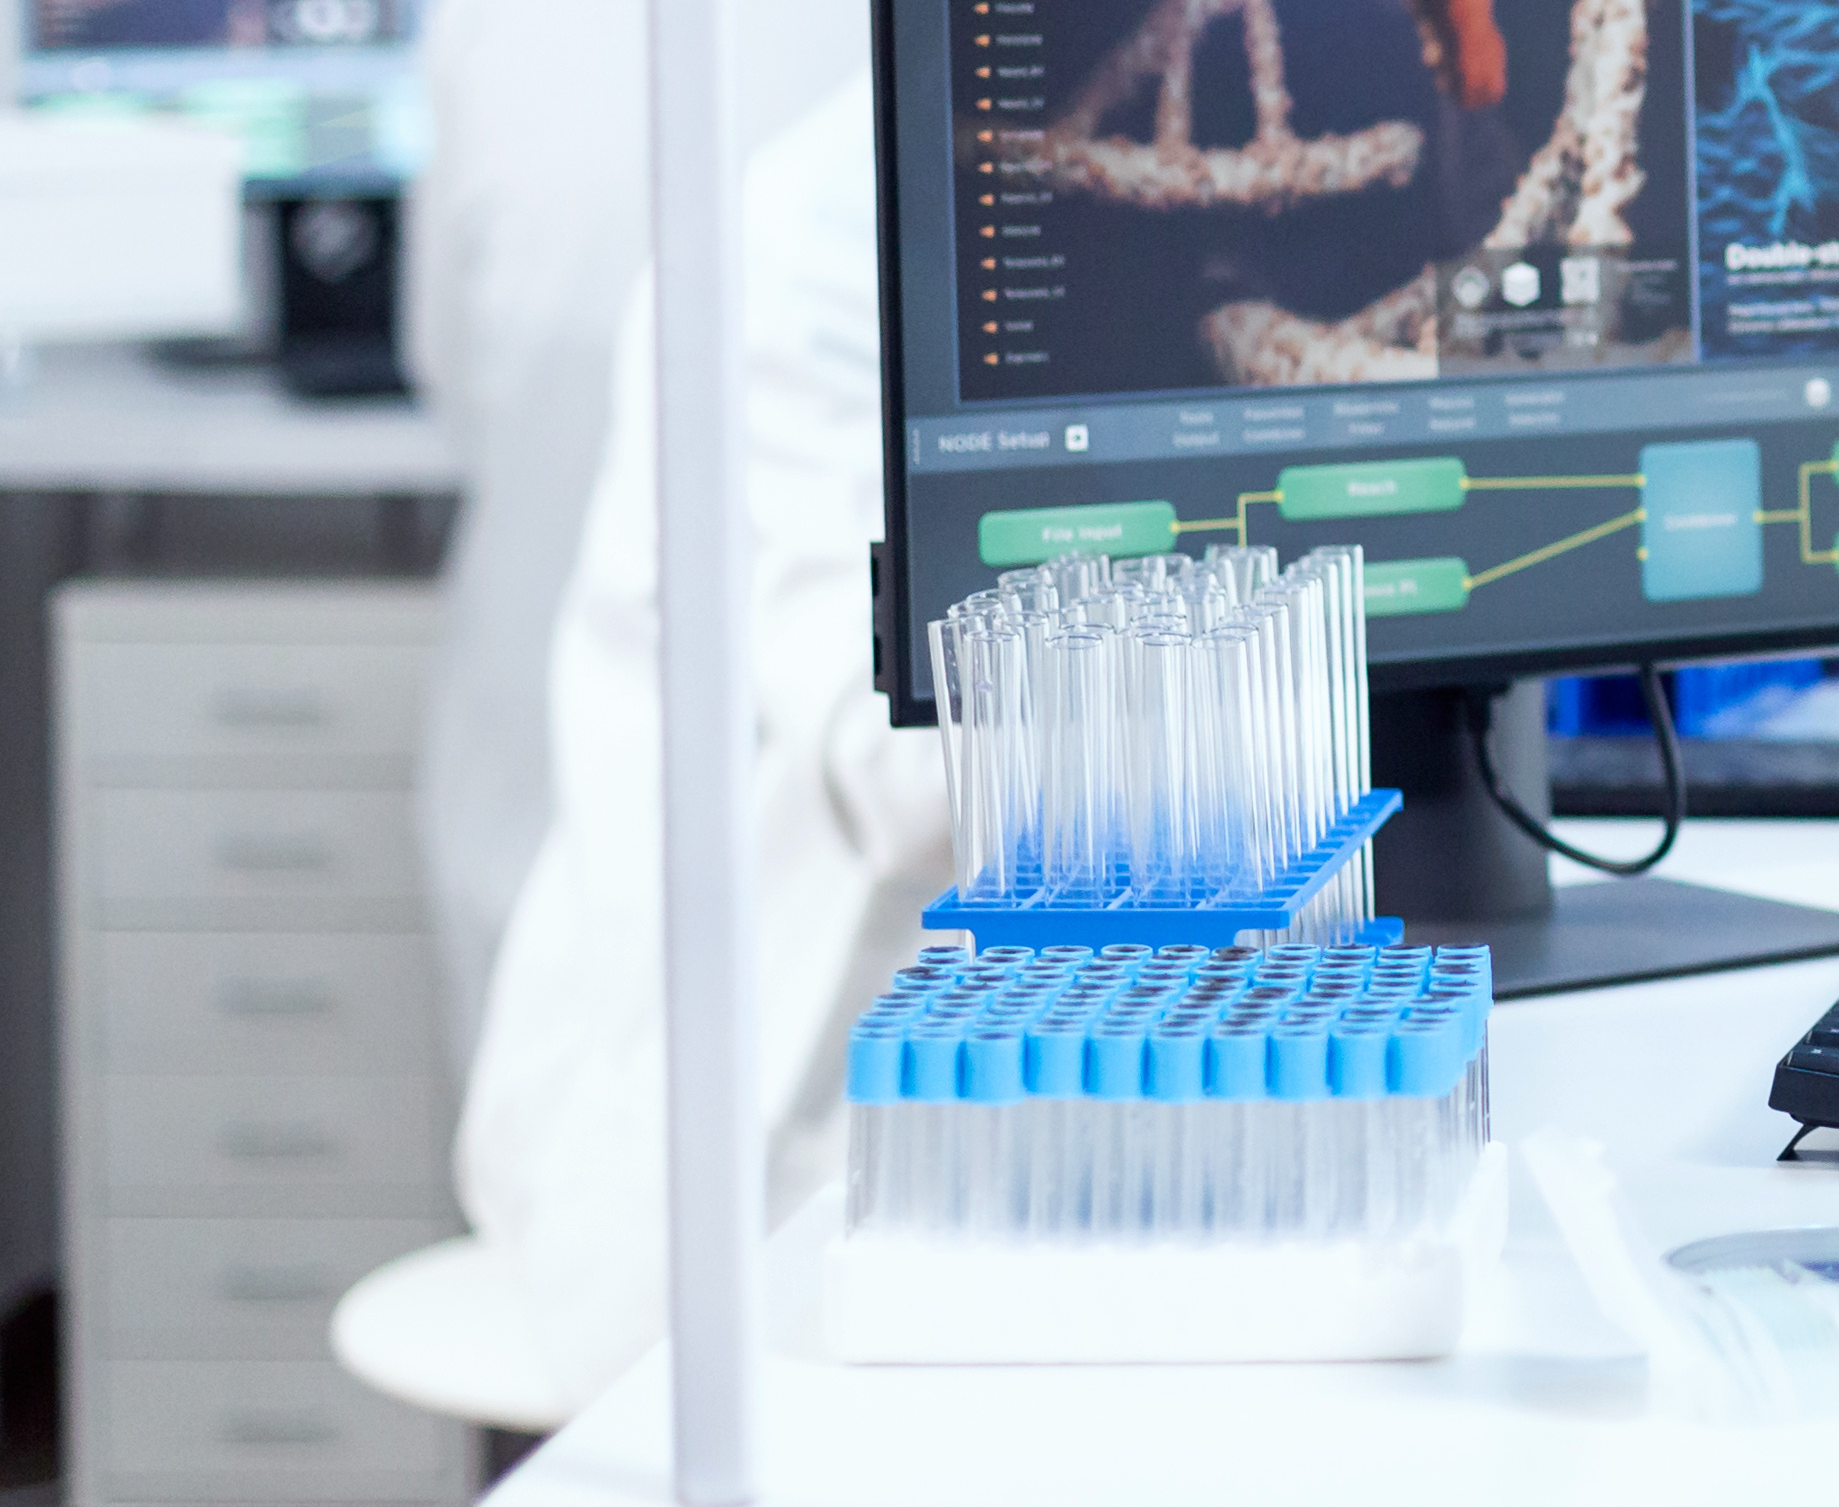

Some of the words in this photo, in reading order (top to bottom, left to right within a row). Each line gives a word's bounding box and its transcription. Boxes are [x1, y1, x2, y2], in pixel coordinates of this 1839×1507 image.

[938, 432, 992, 453] NODE
[996, 430, 1051, 451] Setup
[1041, 526, 1074, 543] File
[1078, 524, 1123, 543] Input
